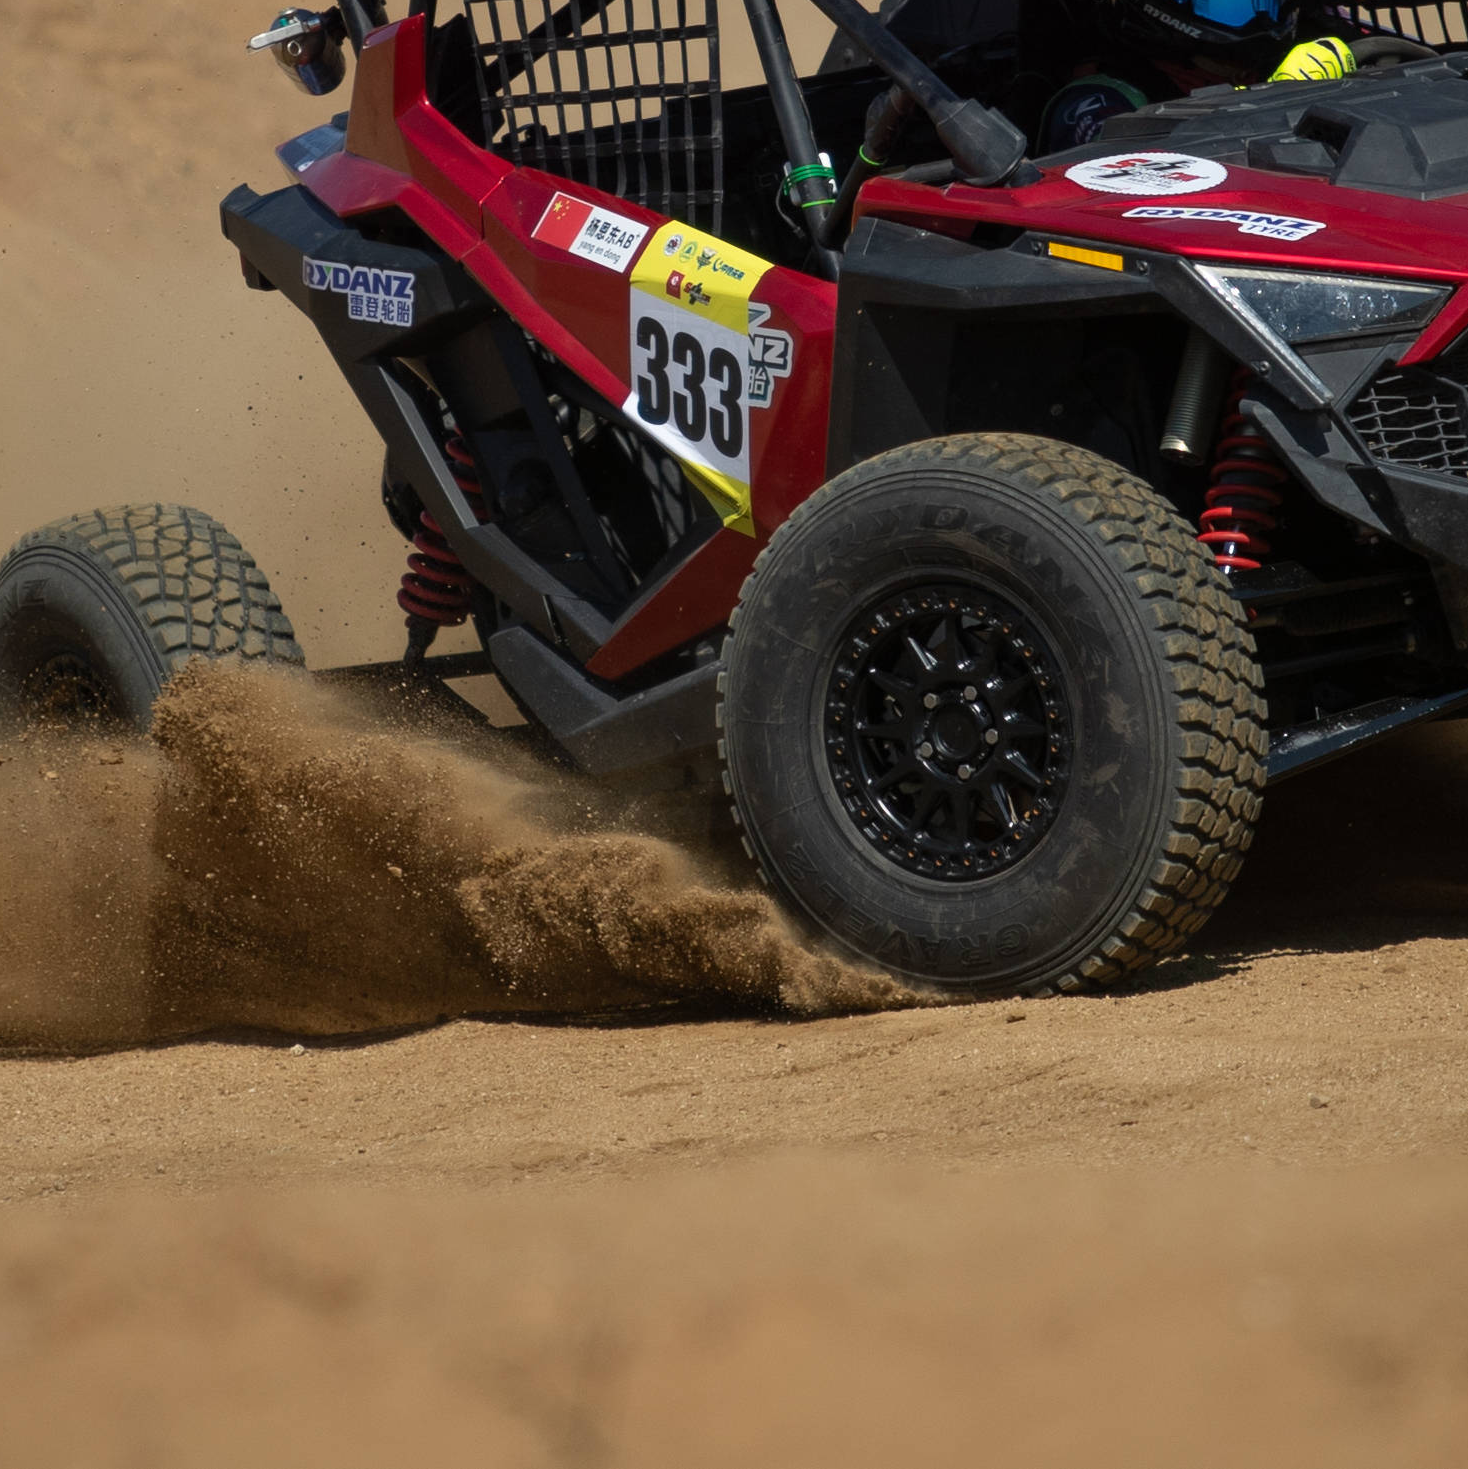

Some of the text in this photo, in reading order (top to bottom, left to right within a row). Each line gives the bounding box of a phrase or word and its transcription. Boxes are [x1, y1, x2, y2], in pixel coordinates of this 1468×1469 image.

[1142, 3, 1203, 40] RYDANZ
[1133, 209, 1317, 231] RYDANZ
[1247, 223, 1301, 238] TYRE
[306, 263, 413, 299] RYDANZ
[350, 294, 411, 324] 雷登轮胎
[636, 315, 743, 458] 333
